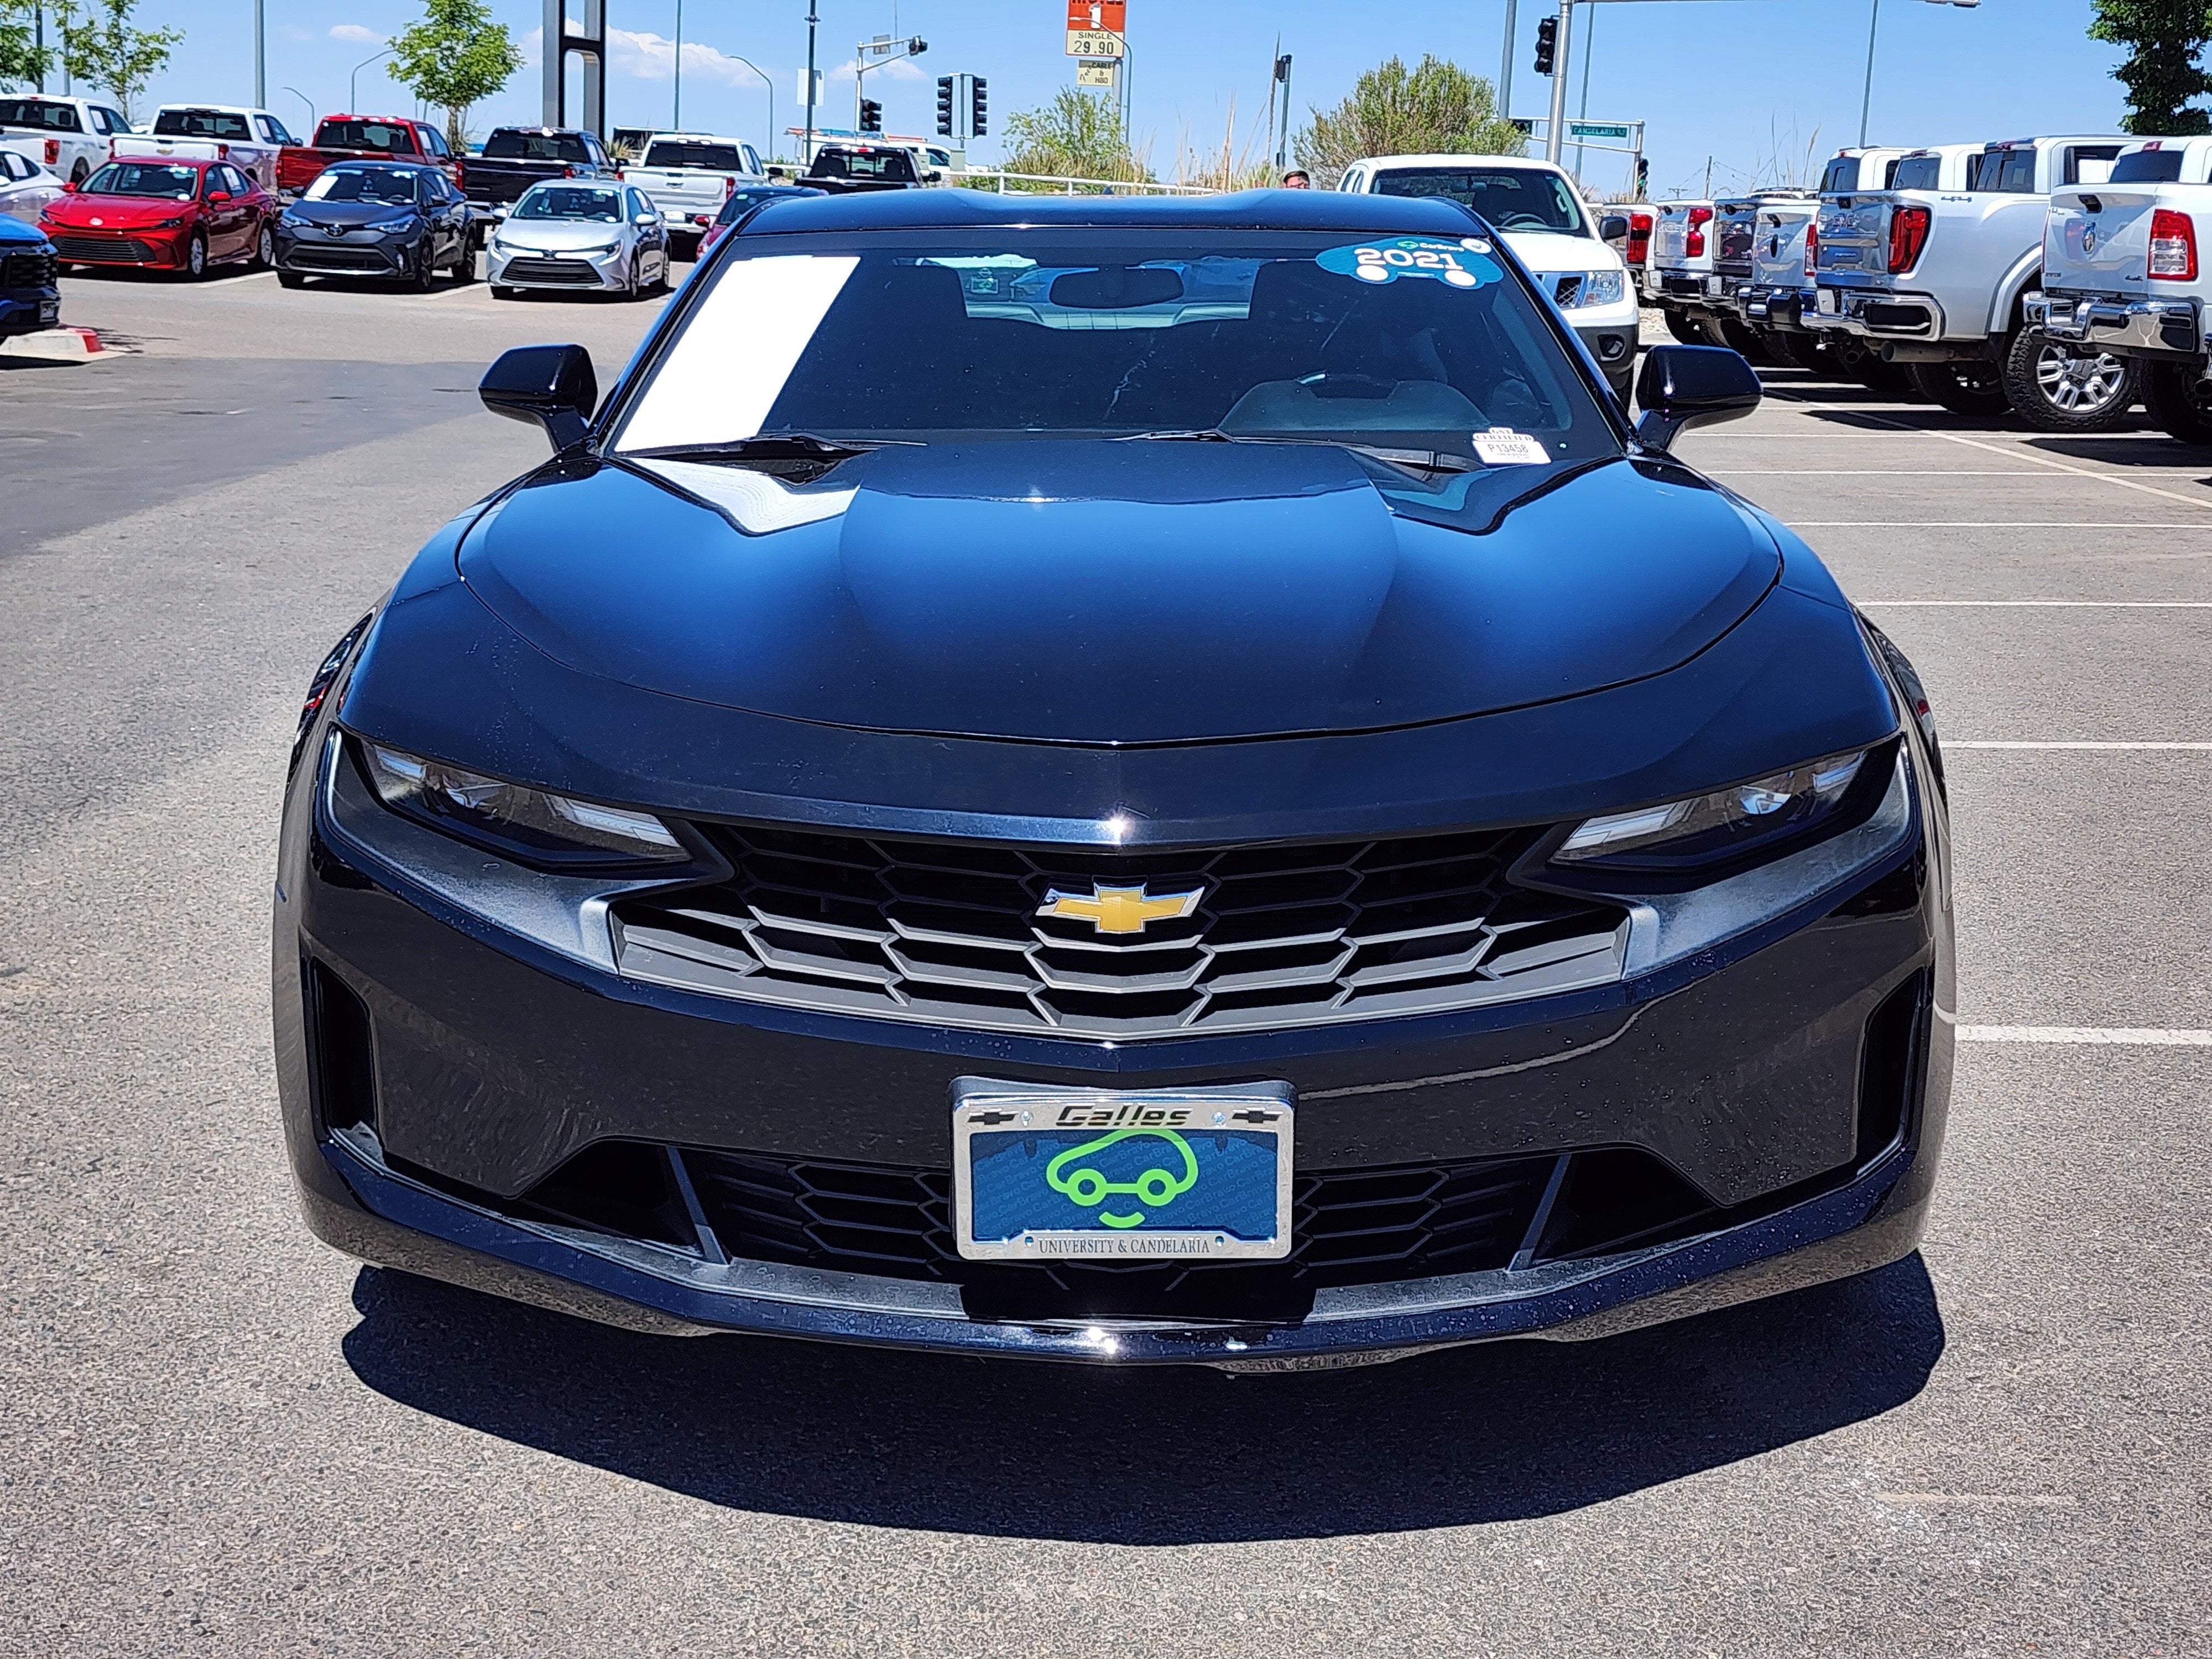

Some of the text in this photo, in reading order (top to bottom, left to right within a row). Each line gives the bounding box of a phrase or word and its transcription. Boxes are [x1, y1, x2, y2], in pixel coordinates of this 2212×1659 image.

[1078, 32, 1113, 40] SINGLE
[1073, 40, 1114, 54] 29.90
[1354, 248, 1463, 270] 2021
[1486, 444, 1529, 453] P13458
[1056, 1103, 1194, 1126] Galles
[1038, 1238, 1210, 1253] UNIVERSITY & CANDELARIA
